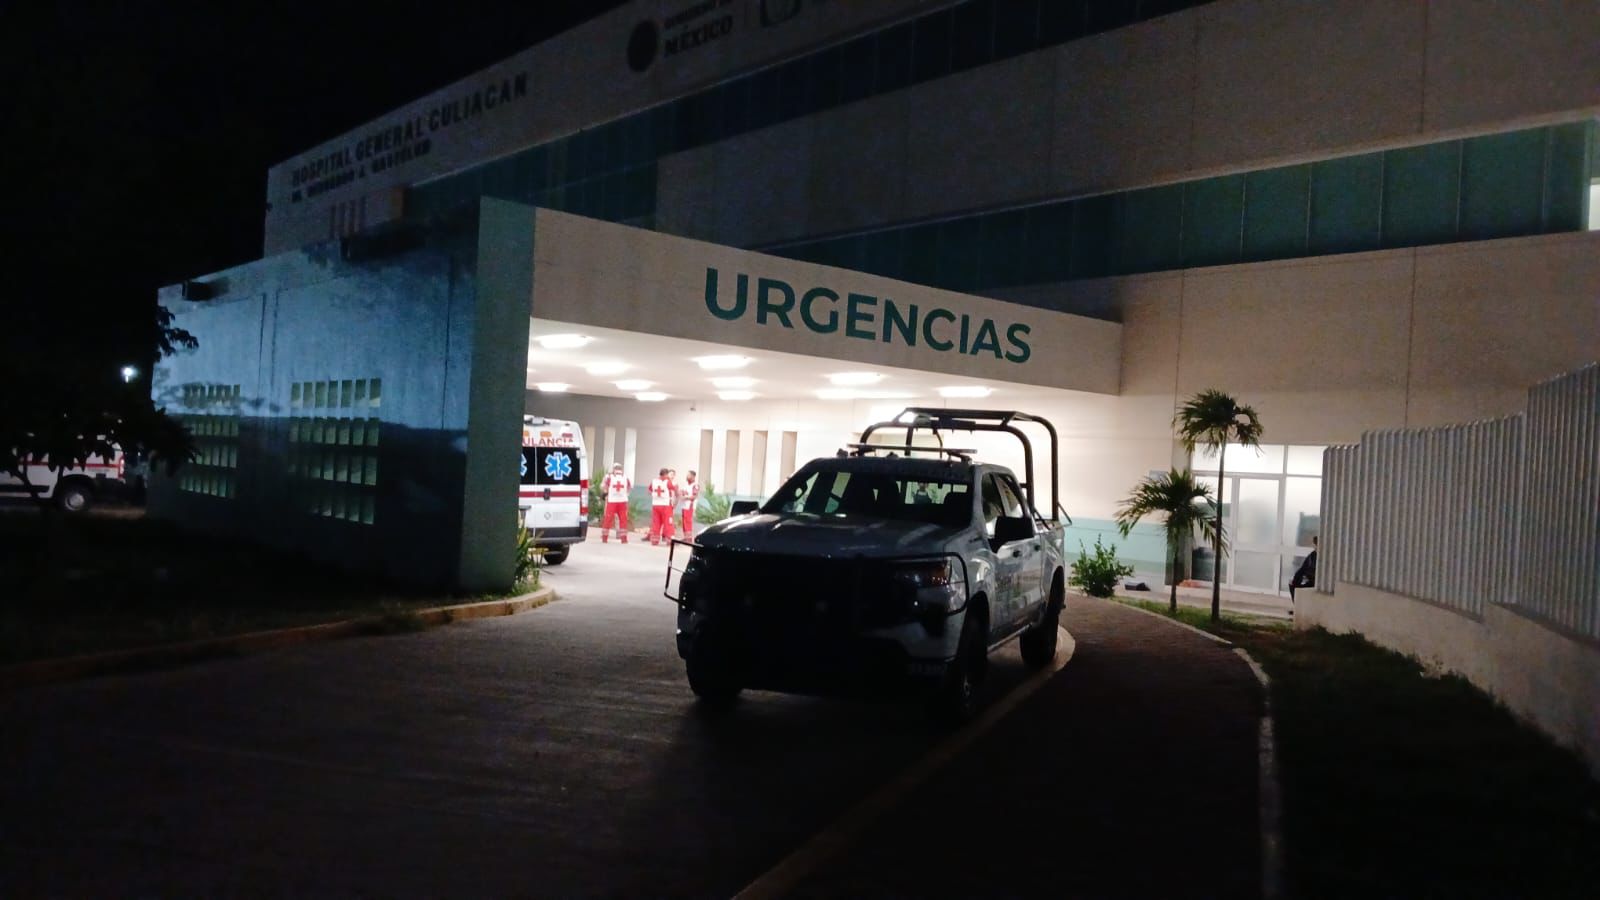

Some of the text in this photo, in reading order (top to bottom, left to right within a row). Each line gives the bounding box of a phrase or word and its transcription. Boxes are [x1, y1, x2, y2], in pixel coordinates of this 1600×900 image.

[292, 146, 352, 188] HOSPITAL
[355, 116, 425, 161] GENERAL
[704, 267, 1031, 364] URGENCIAS
